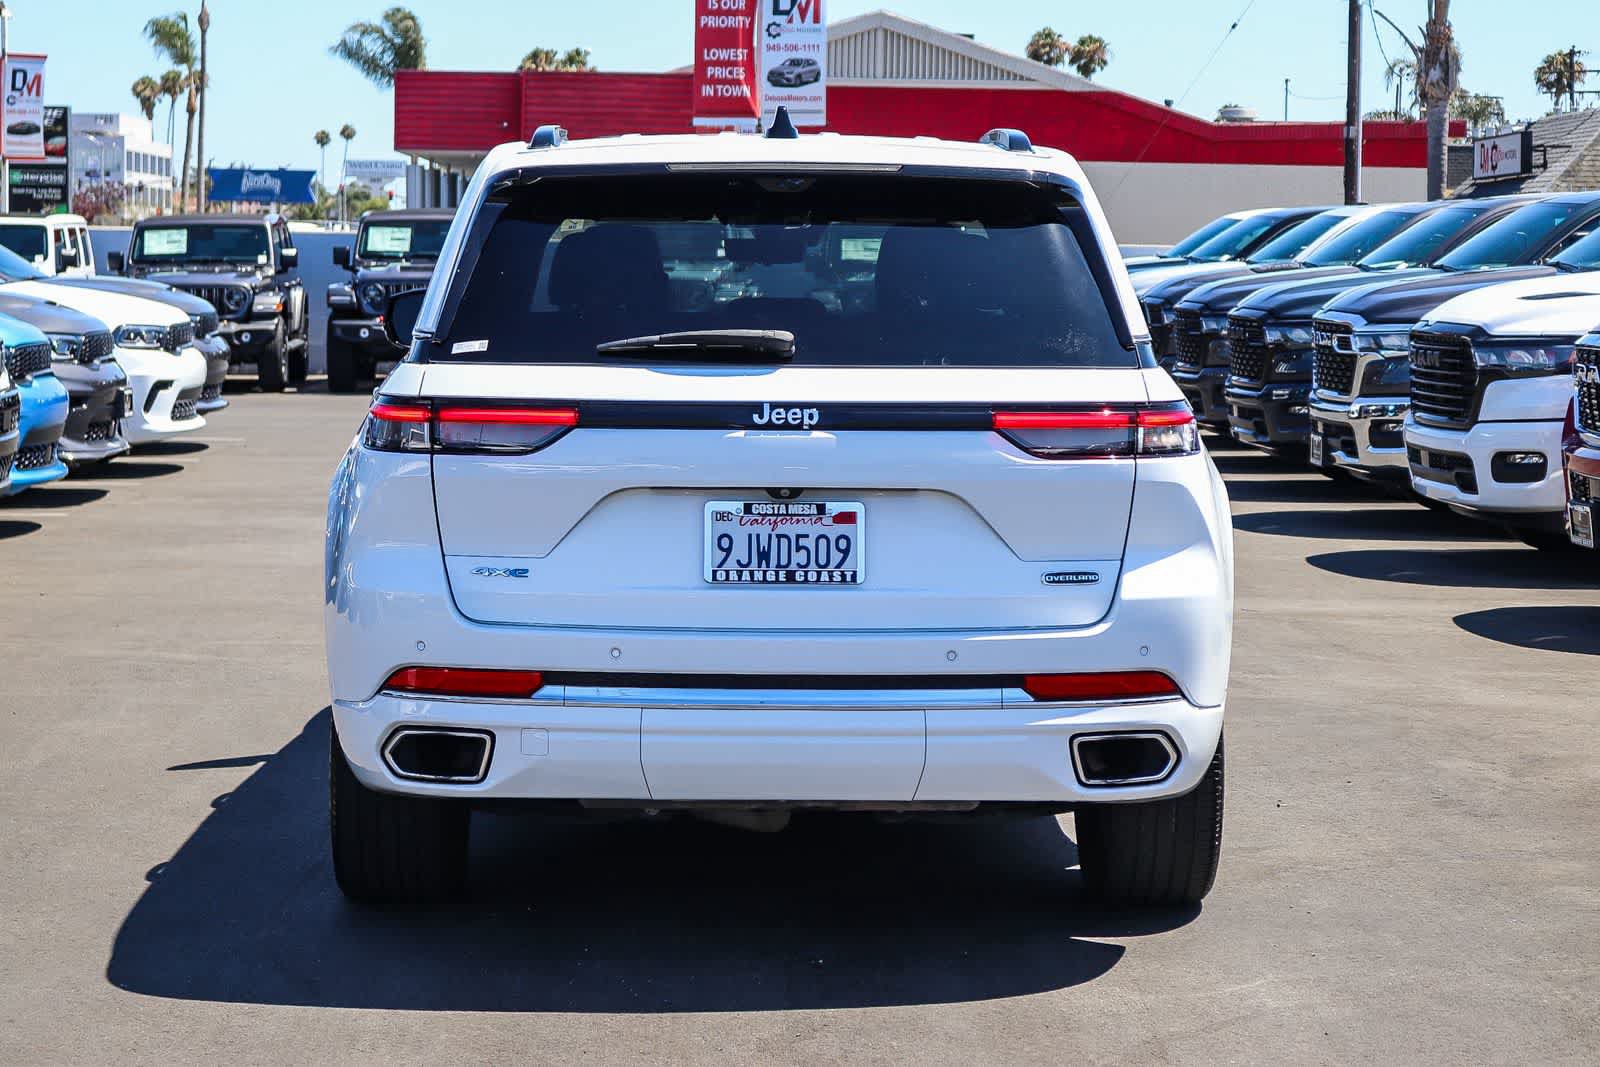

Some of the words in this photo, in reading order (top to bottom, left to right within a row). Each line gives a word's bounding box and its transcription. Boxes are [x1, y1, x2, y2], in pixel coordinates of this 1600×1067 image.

[708, 0, 719, 9] IS
[721, 0, 746, 9] OUR
[701, 15, 751, 29] PRIORITY
[704, 48, 748, 61] LOWEST
[707, 66, 746, 80] PRICES
[702, 84, 715, 97] IN
[717, 84, 751, 97] TOWN
[753, 402, 819, 429] Jeep
[751, 503, 787, 515] COSTA
[788, 503, 818, 515] MESA
[715, 511, 733, 522] DEC
[717, 533, 852, 569] 9JWD509
[716, 570, 787, 582] ORANGE
[795, 570, 853, 582] COAST
[1045, 574, 1099, 582] OVERLAND
